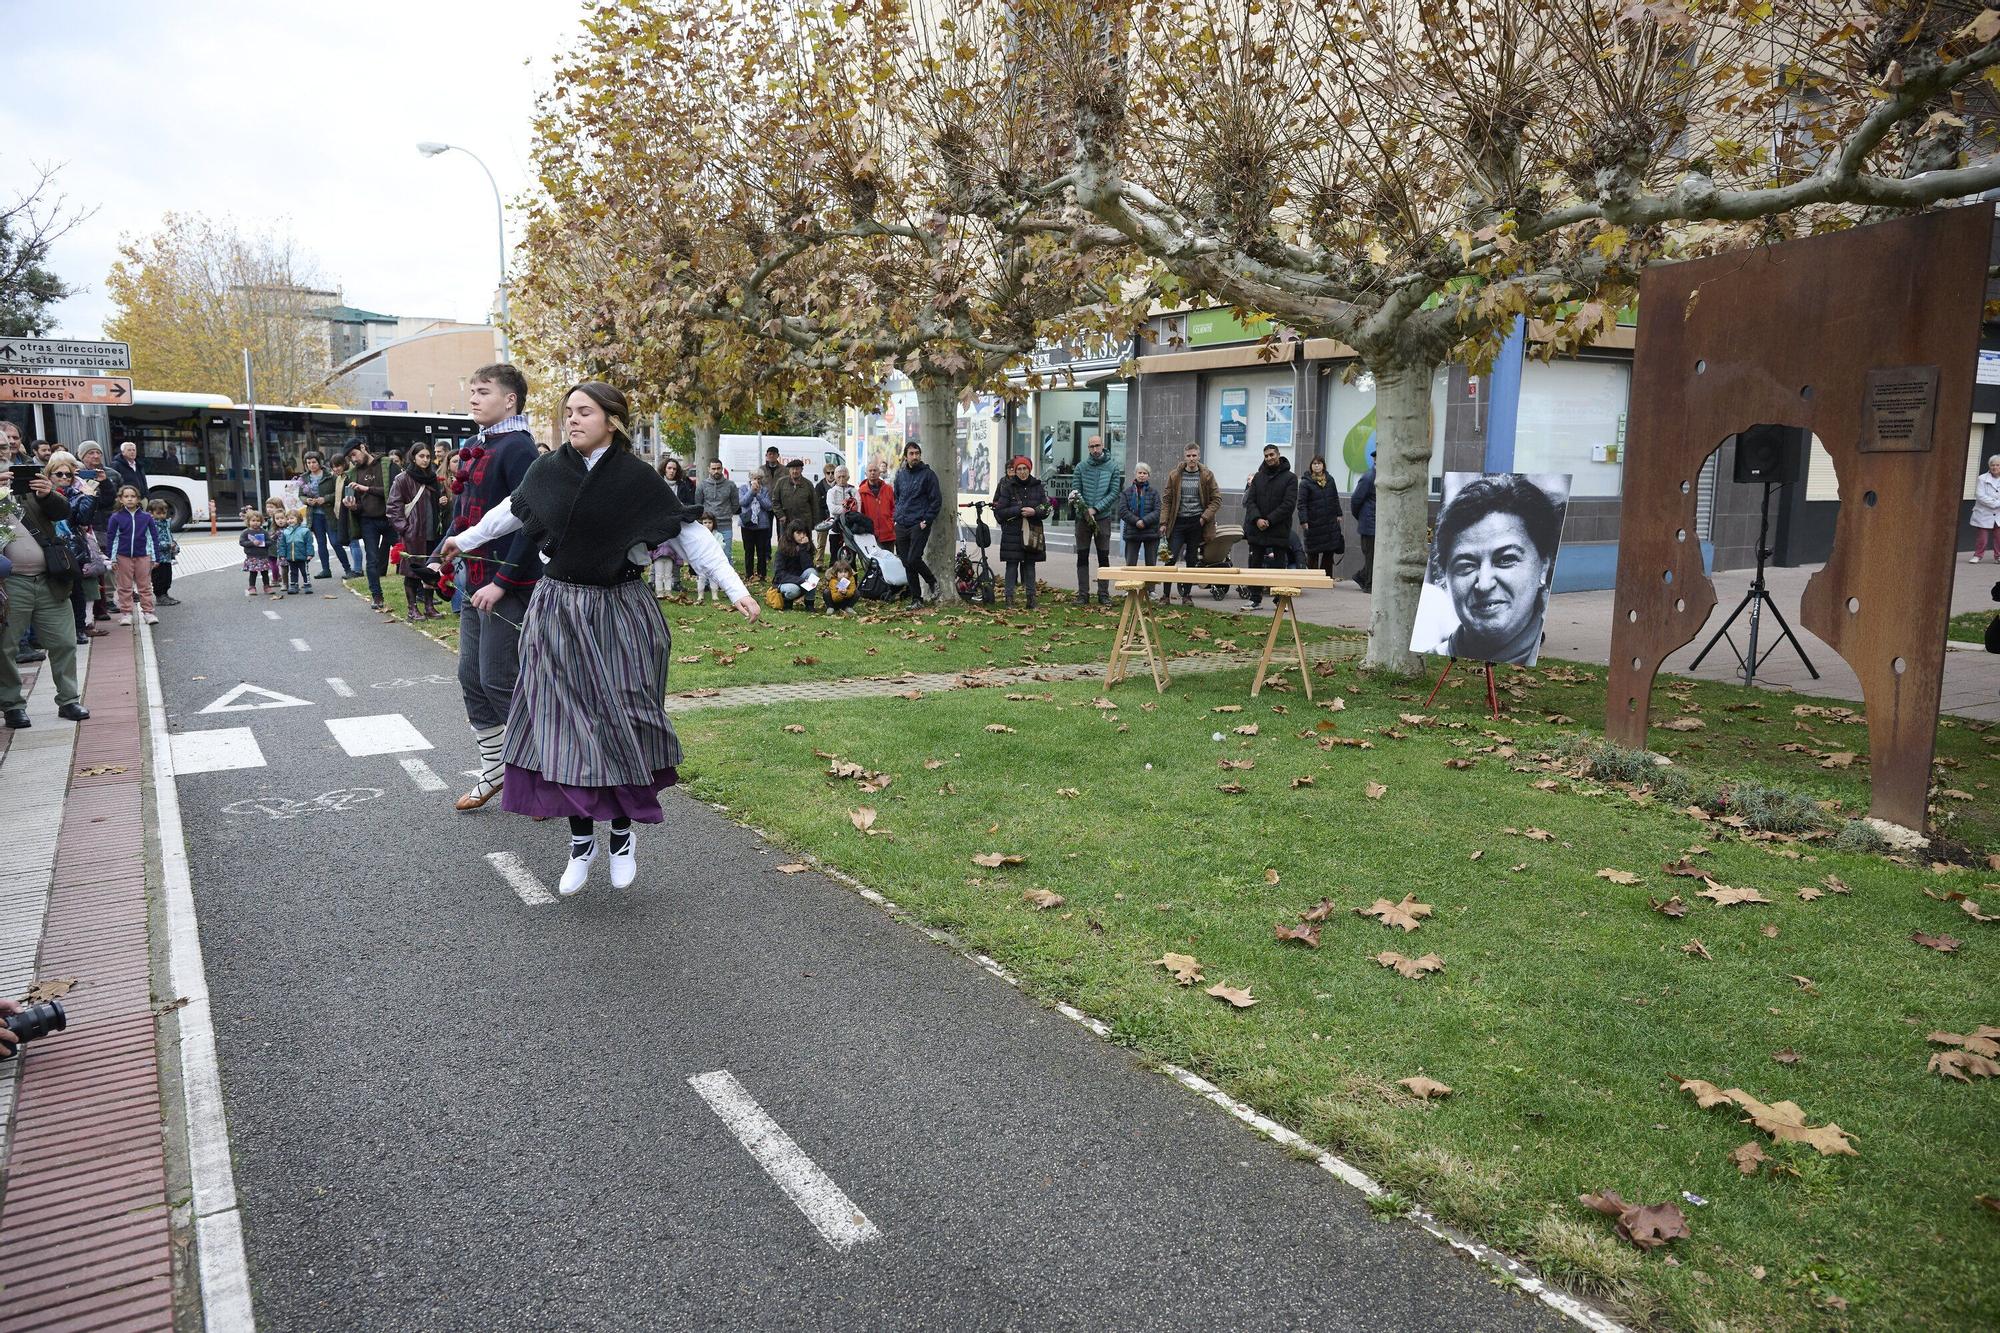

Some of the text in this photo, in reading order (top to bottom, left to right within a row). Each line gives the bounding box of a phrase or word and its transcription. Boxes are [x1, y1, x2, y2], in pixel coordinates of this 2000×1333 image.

[20, 343, 124, 355] otras direcciones
[21, 355, 125, 367] beste norabideak
[0, 376, 85, 388] polideportivo
